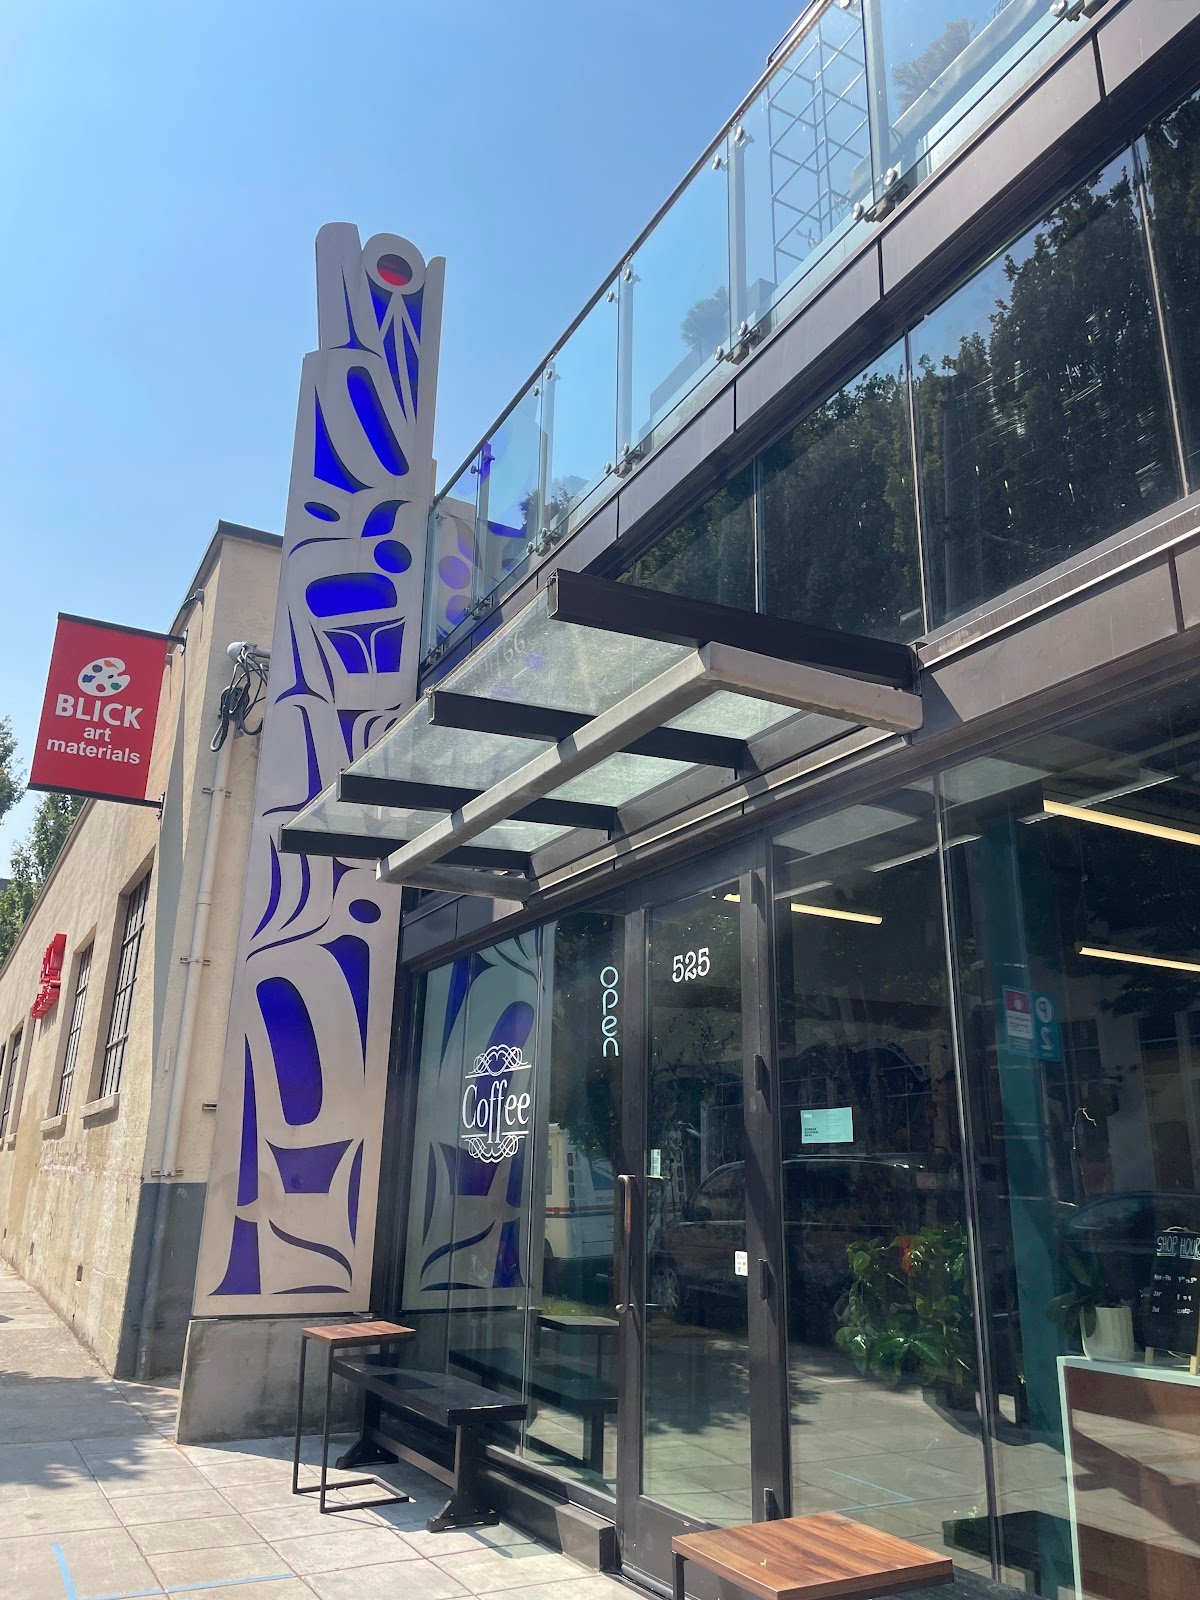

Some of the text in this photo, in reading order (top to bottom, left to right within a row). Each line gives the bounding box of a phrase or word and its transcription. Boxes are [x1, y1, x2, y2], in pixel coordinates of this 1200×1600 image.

[55, 693, 143, 730] BLICK
[46, 738, 141, 765] materials
[83, 726, 112, 742] art
[672, 946, 711, 983] 525
[600, 966, 619, 1058] open
[462, 1079, 531, 1144] Coffee
[1156, 1235, 1178, 1254] SHOP
